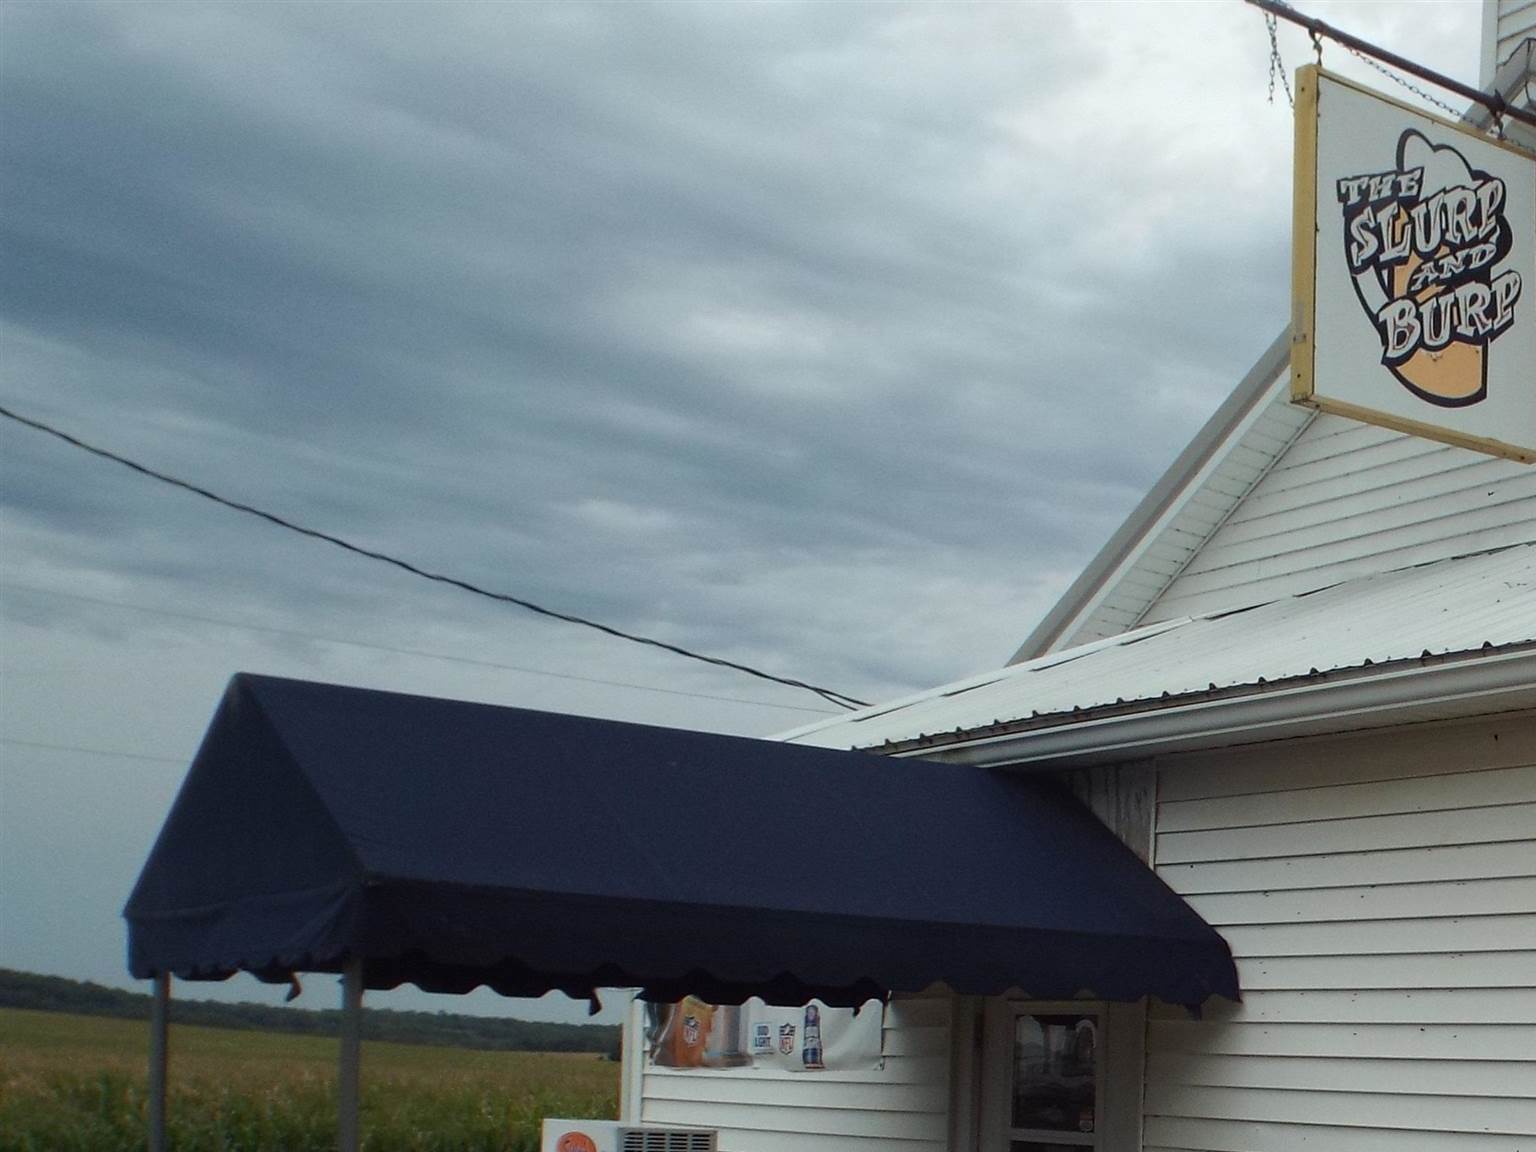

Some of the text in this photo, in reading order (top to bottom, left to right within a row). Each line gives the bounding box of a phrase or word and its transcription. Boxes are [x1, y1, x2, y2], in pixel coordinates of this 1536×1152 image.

[1339, 172, 1423, 204] THE
[1350, 178, 1505, 266] SLURP
[1411, 242, 1499, 291] AND
[1377, 271, 1522, 359] BURP
